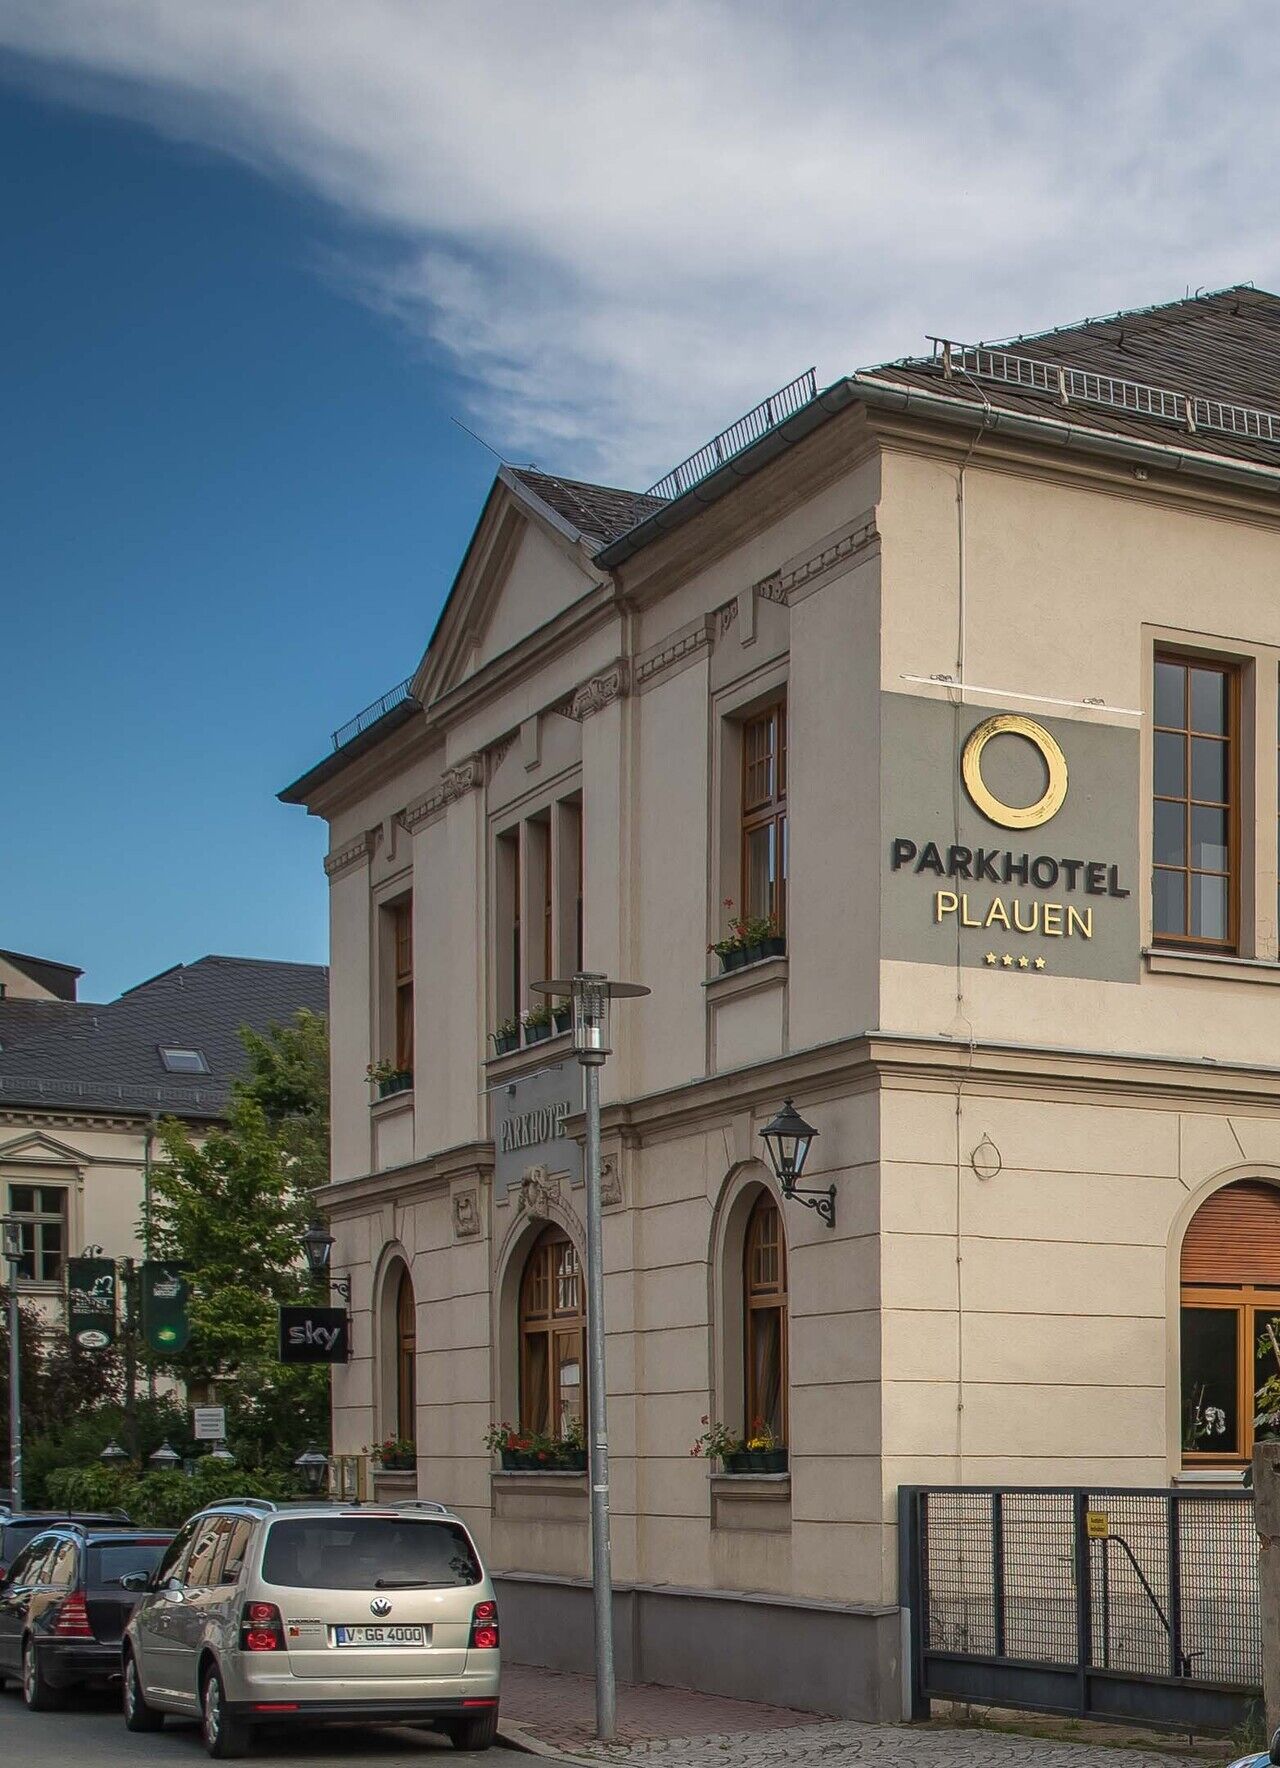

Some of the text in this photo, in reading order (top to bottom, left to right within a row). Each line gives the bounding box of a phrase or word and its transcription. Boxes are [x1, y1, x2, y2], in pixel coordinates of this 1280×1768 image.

[892, 838, 1130, 898] PARKHOTEL
[935, 890, 1093, 938] PLAUEN
[289, 1320, 341, 1351] sky
[346, 1628, 356, 1641] V
[365, 1628, 384, 1641] GG
[387, 1628, 421, 1641] 4000
